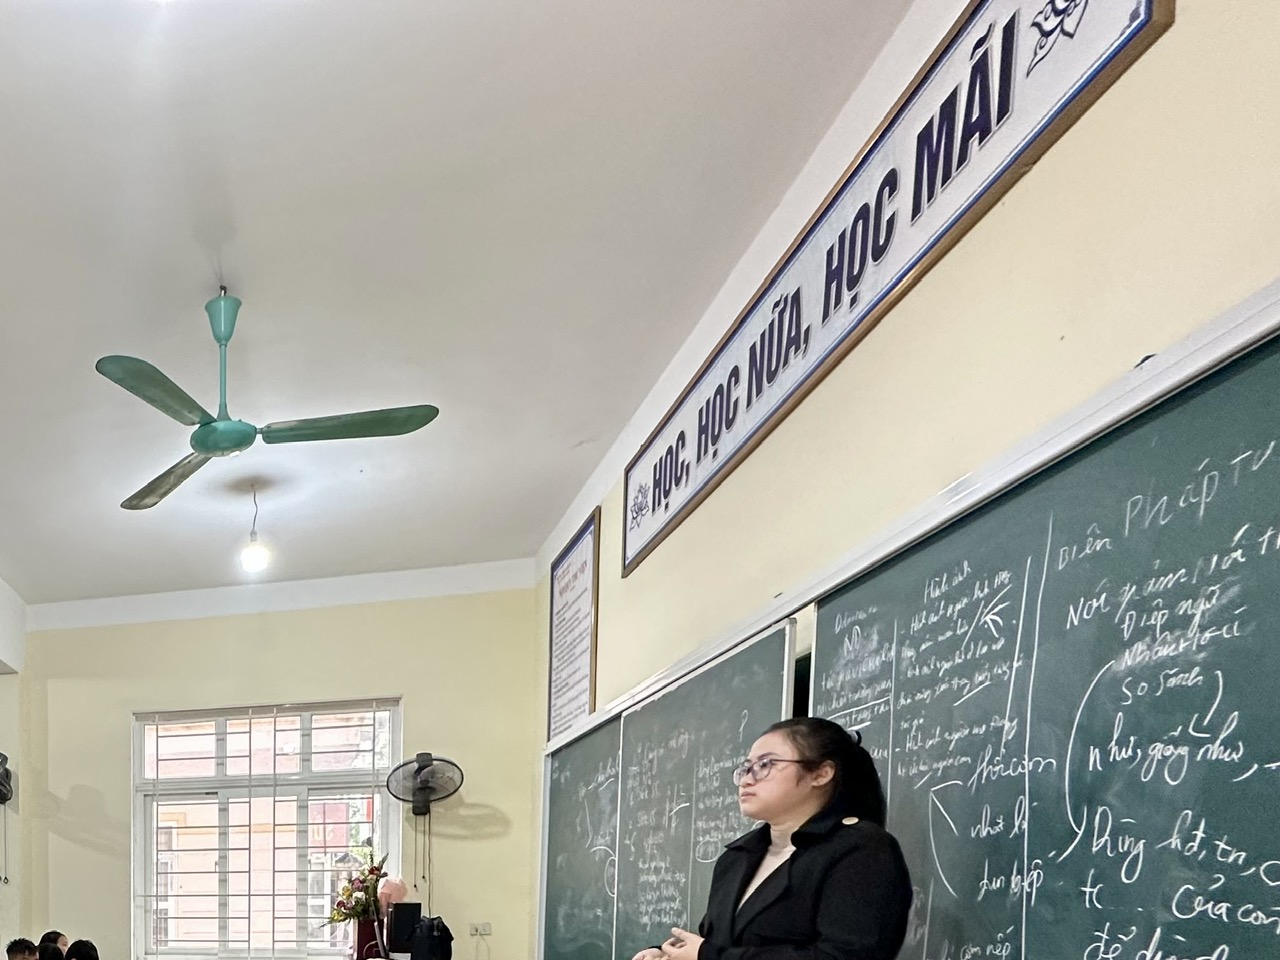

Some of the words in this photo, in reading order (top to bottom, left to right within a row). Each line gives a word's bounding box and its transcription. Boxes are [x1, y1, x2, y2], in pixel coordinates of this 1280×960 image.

[651, 429, 690, 513] HỌC,
[695, 365, 739, 461] HỌC
[746, 287, 811, 409] NỮA,
[822, 167, 898, 326] HỌC
[910, 9, 1019, 222] MÃI
